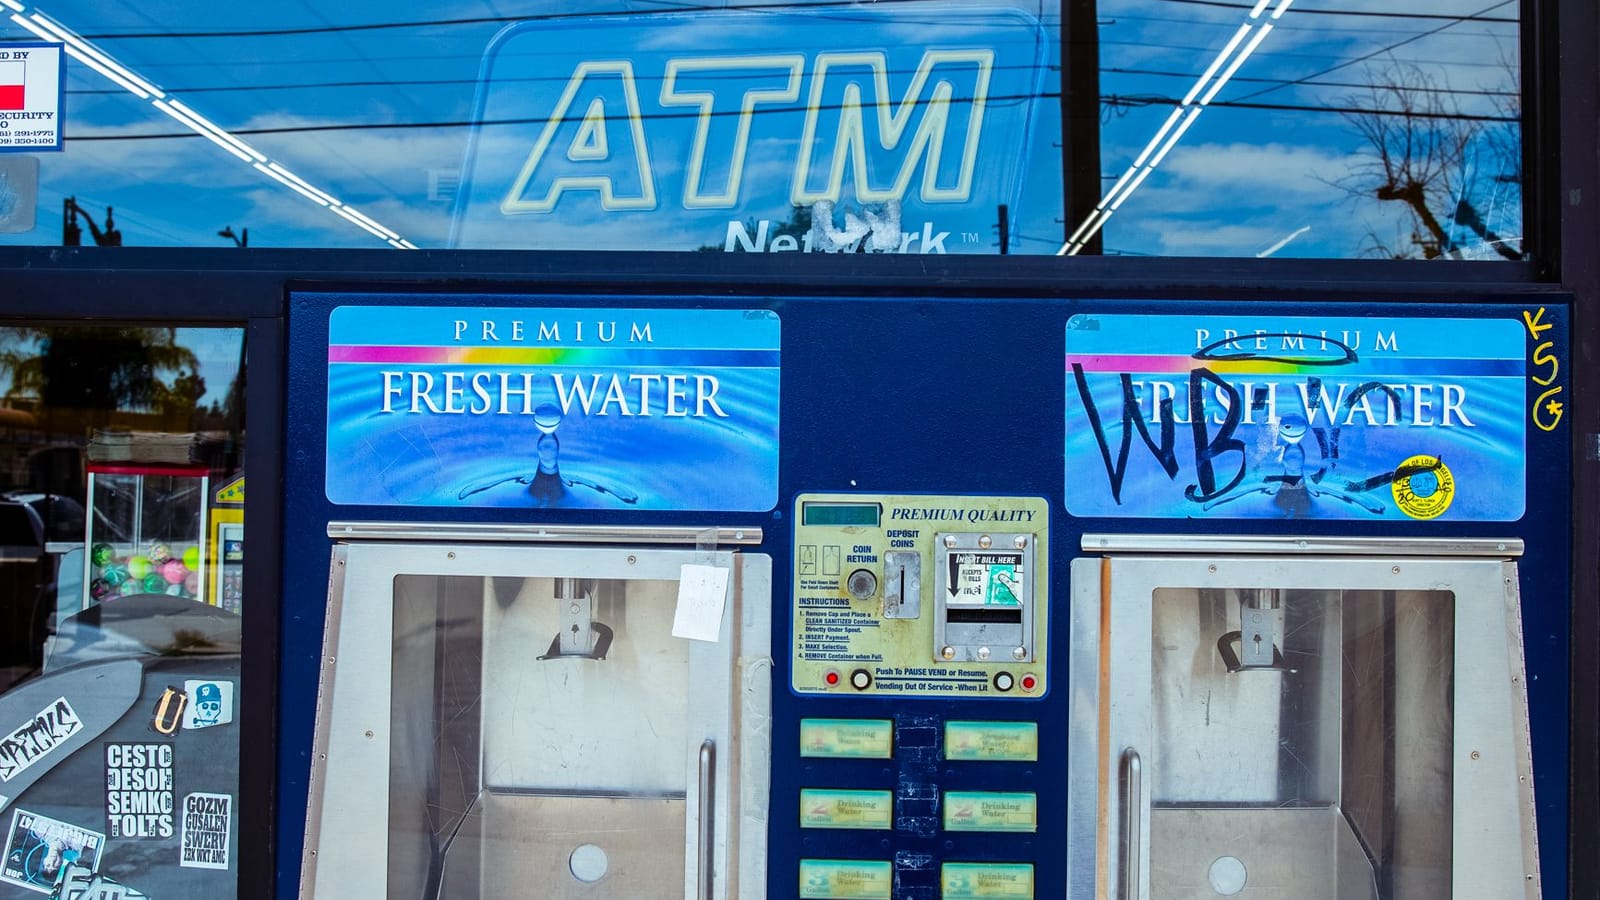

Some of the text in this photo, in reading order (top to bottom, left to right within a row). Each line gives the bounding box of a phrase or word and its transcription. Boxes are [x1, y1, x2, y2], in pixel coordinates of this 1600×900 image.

[13, 51, 30, 60] BY
[501, 49, 994, 214] ATM
[454, 320, 654, 342] PREMIUM
[1195, 329, 1400, 352] PREMIUM
[380, 371, 730, 418] FRESH WATER
[1296, 381, 1477, 428] WATER
[891, 508, 1037, 523] PREMIUM QUALITY
[886, 530, 920, 539] DEPOSIT
[853, 545, 872, 554] COIN
[890, 540, 915, 549] COINS
[846, 555, 878, 564] RETURN
[981, 556, 997, 564] BILL
[799, 597, 850, 606] INSTRUCTIONS
[904, 668, 927, 676] PAUSE
[958, 669, 988, 677] Resume.
[875, 682, 903, 690] Vending
[904, 682, 917, 690] Out
[928, 683, 954, 691] Service
[978, 684, 988, 692] Lit
[837, 799, 877, 809] Drinking
[981, 801, 1021, 811] Drinking
[837, 807, 862, 816] Water
[981, 809, 1007, 818] Water
[184, 830, 227, 850] SWERV
[977, 871, 1017, 882] Drinking
